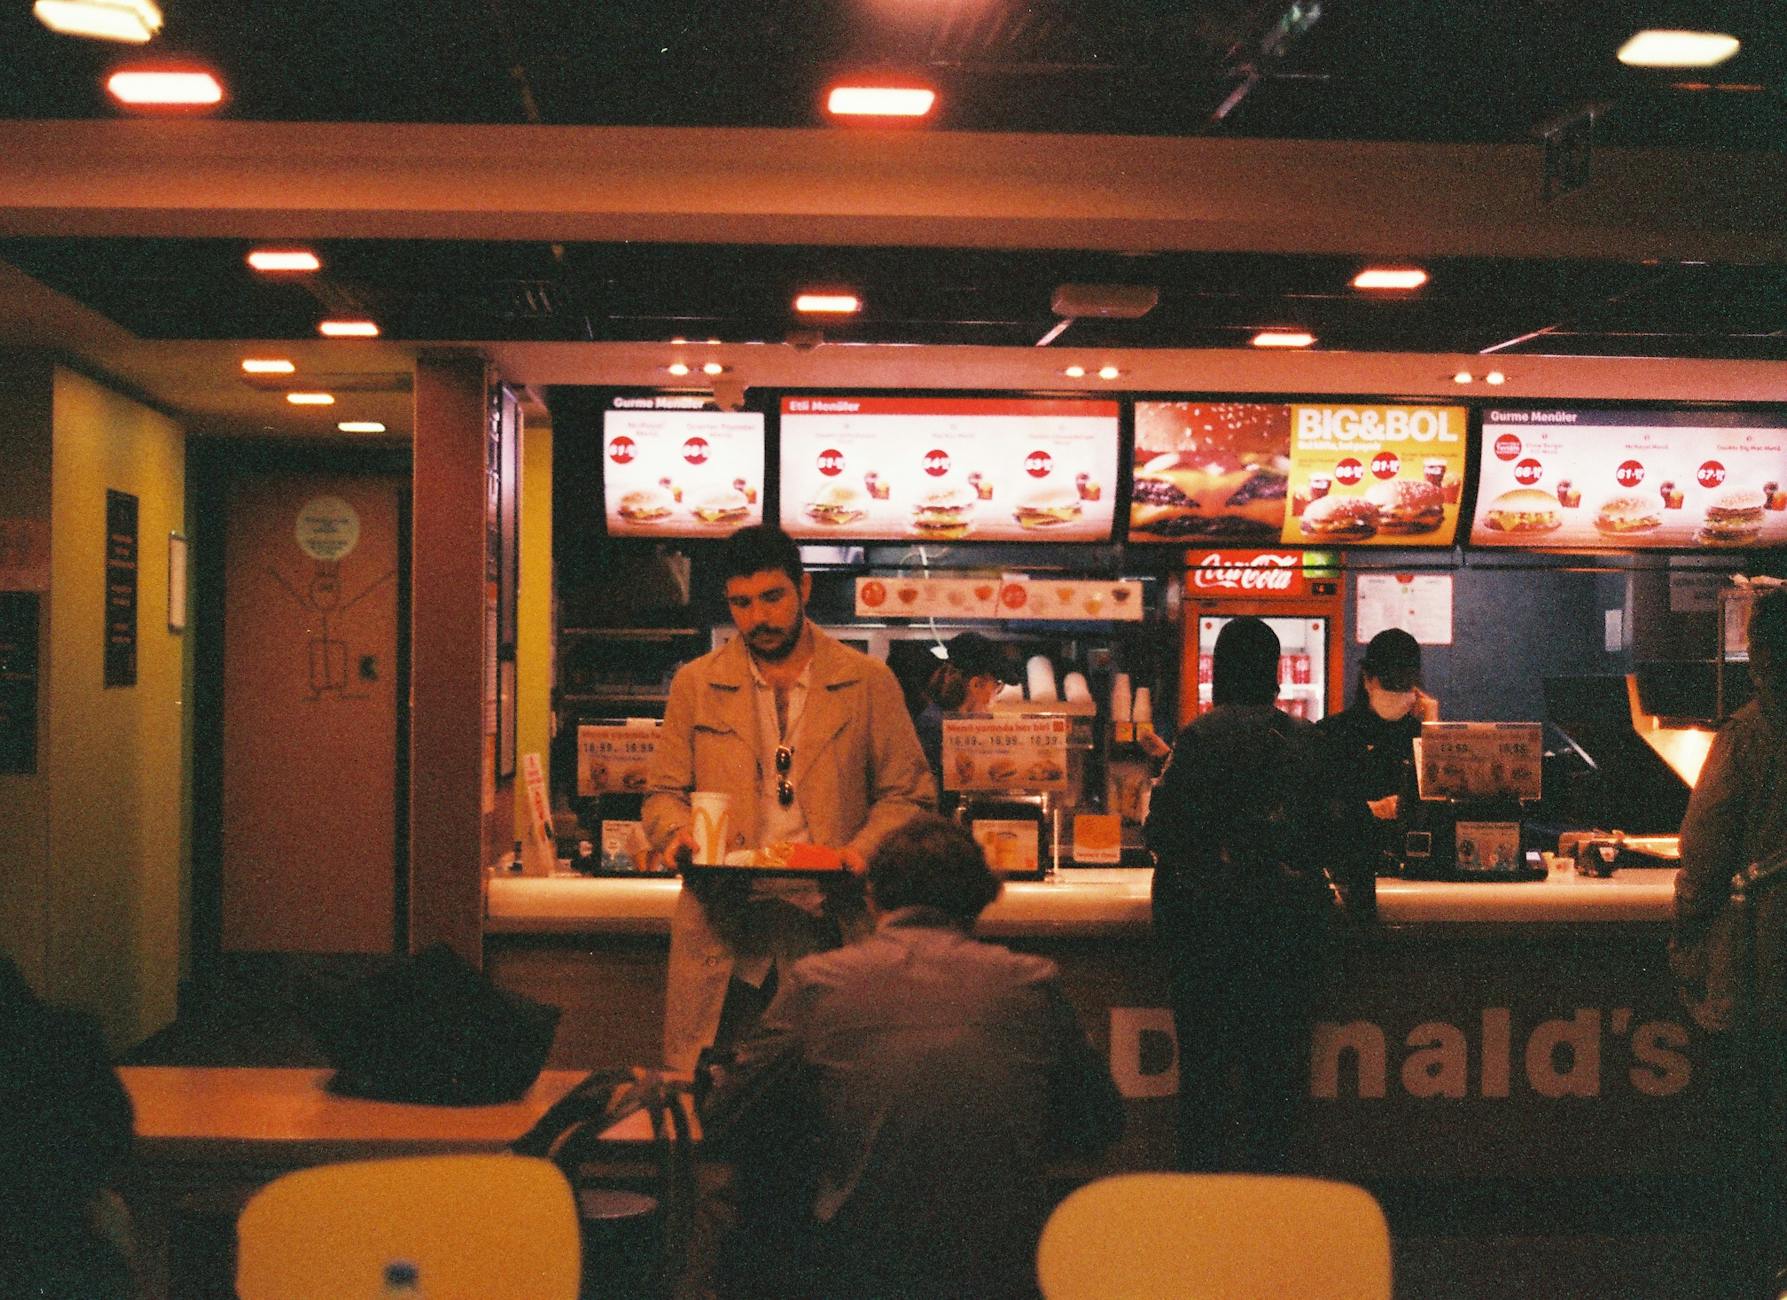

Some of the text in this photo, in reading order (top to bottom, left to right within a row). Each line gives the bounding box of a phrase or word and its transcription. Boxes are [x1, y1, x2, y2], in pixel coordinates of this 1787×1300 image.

[1298, 408, 1459, 442] BIG&BOL
[1490, 411, 1578, 422] Gurme Menüler
[1110, 1006, 1692, 1098] Dnald's
